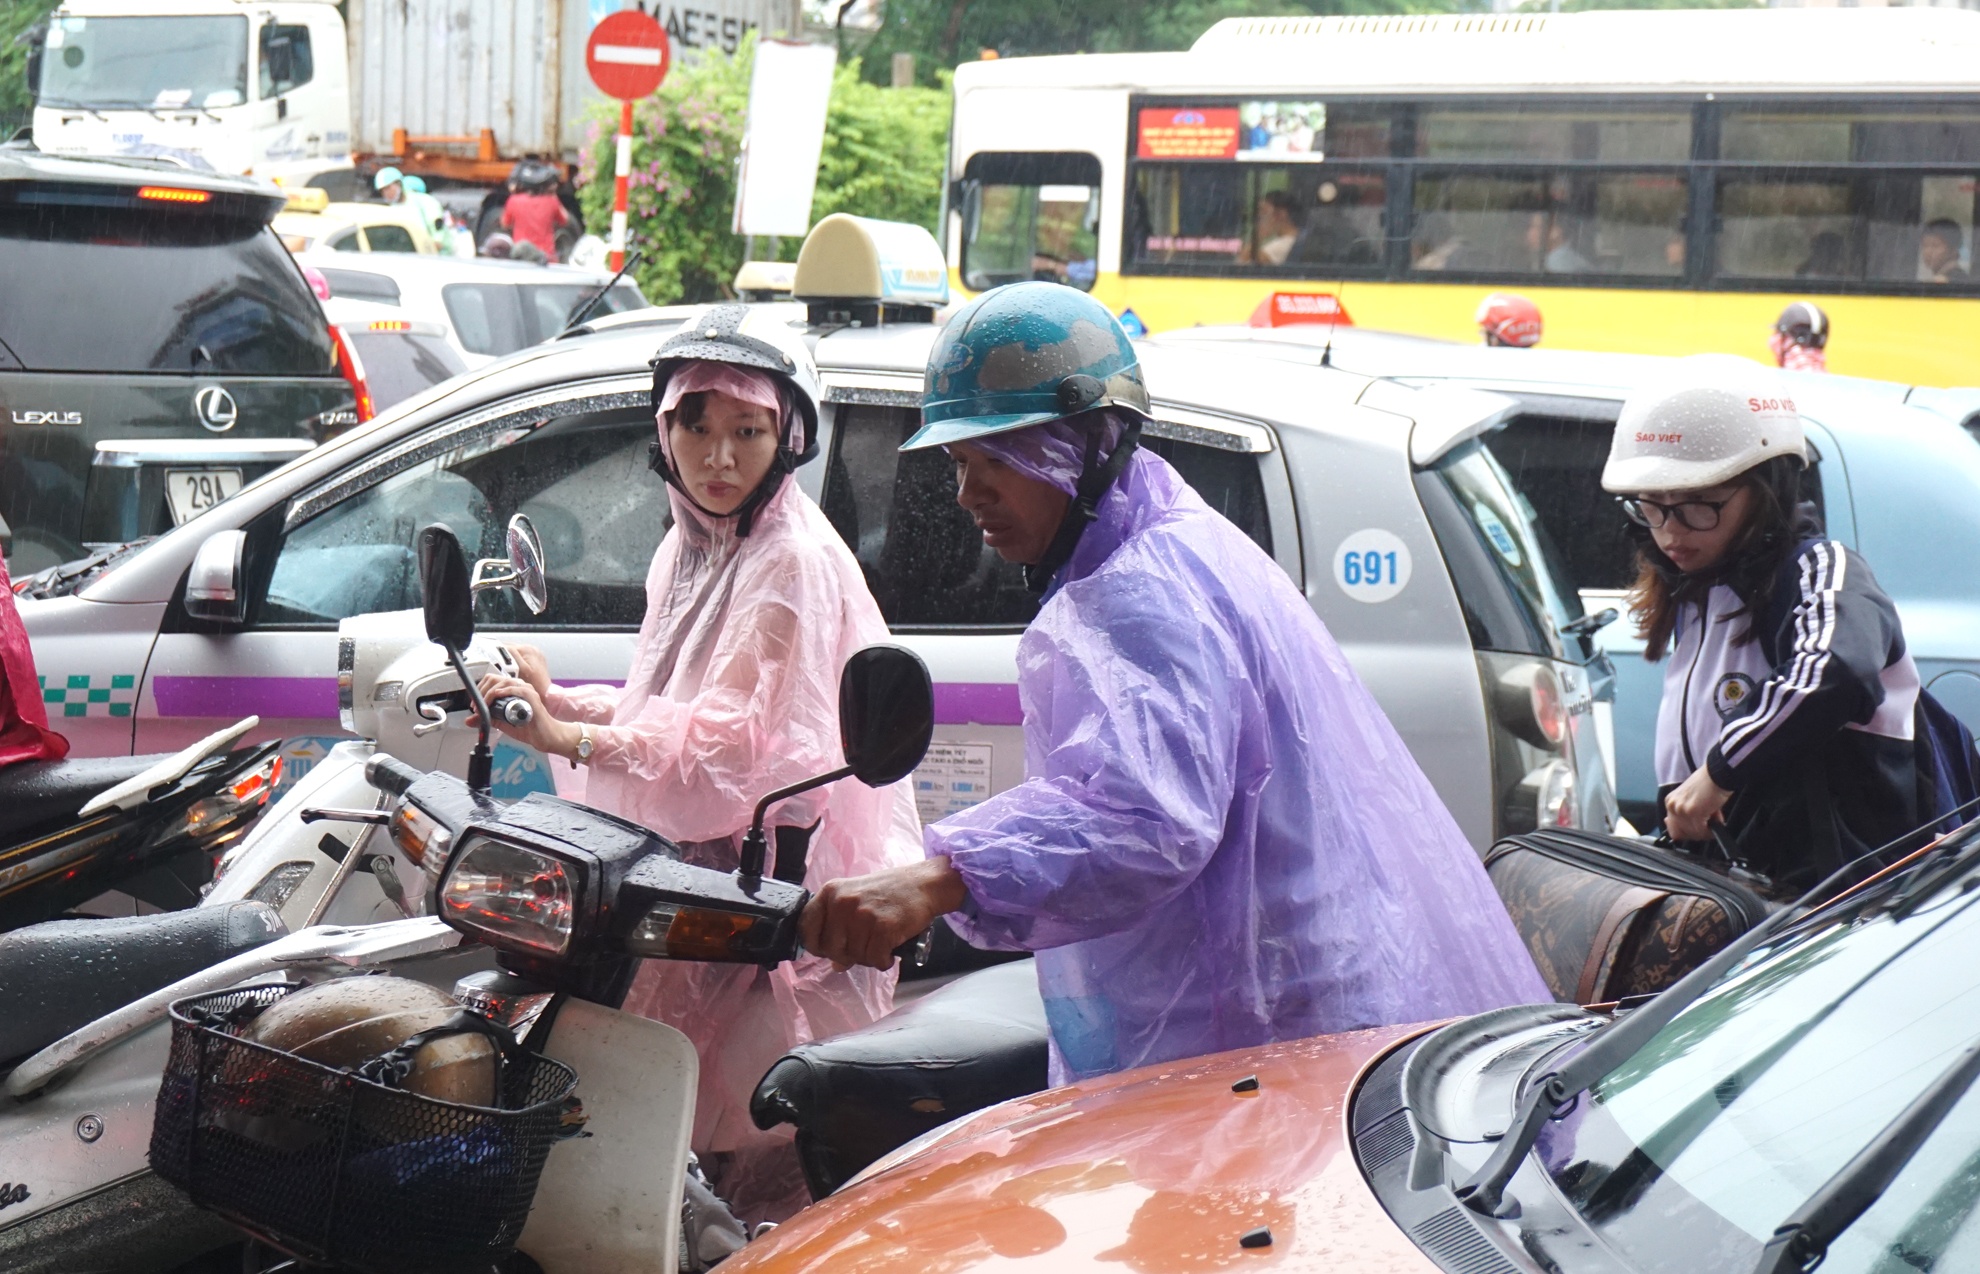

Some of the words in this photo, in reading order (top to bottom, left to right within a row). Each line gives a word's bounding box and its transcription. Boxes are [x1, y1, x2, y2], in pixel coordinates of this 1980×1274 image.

[1748, 397, 1779, 412] SAO
[12, 410, 82, 425] LEXUS
[1635, 432, 1655, 442] SAO
[1344, 551, 1397, 586] 691
